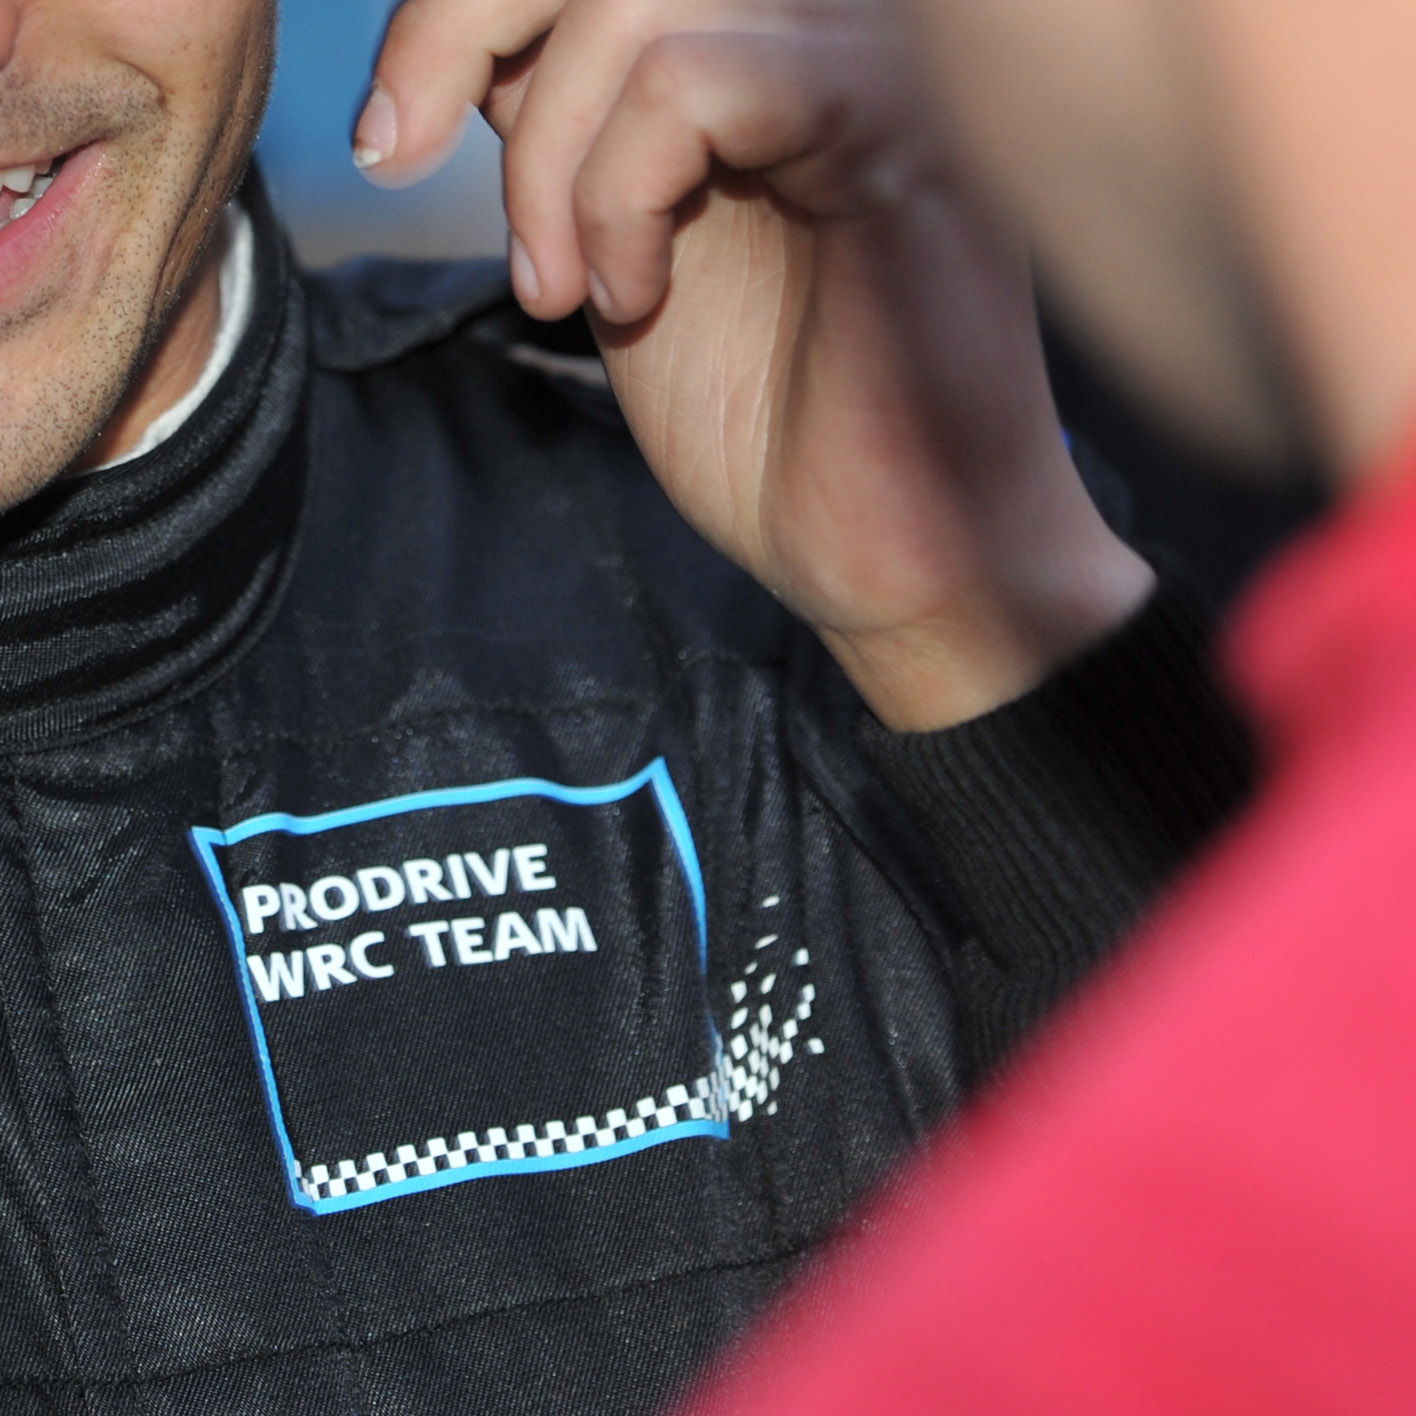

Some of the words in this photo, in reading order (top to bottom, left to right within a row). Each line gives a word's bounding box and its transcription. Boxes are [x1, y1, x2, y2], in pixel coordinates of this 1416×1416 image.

[240, 843, 557, 935] PRODRIVE
[246, 931, 395, 1002] WRC
[408, 906, 598, 968] TEAM
